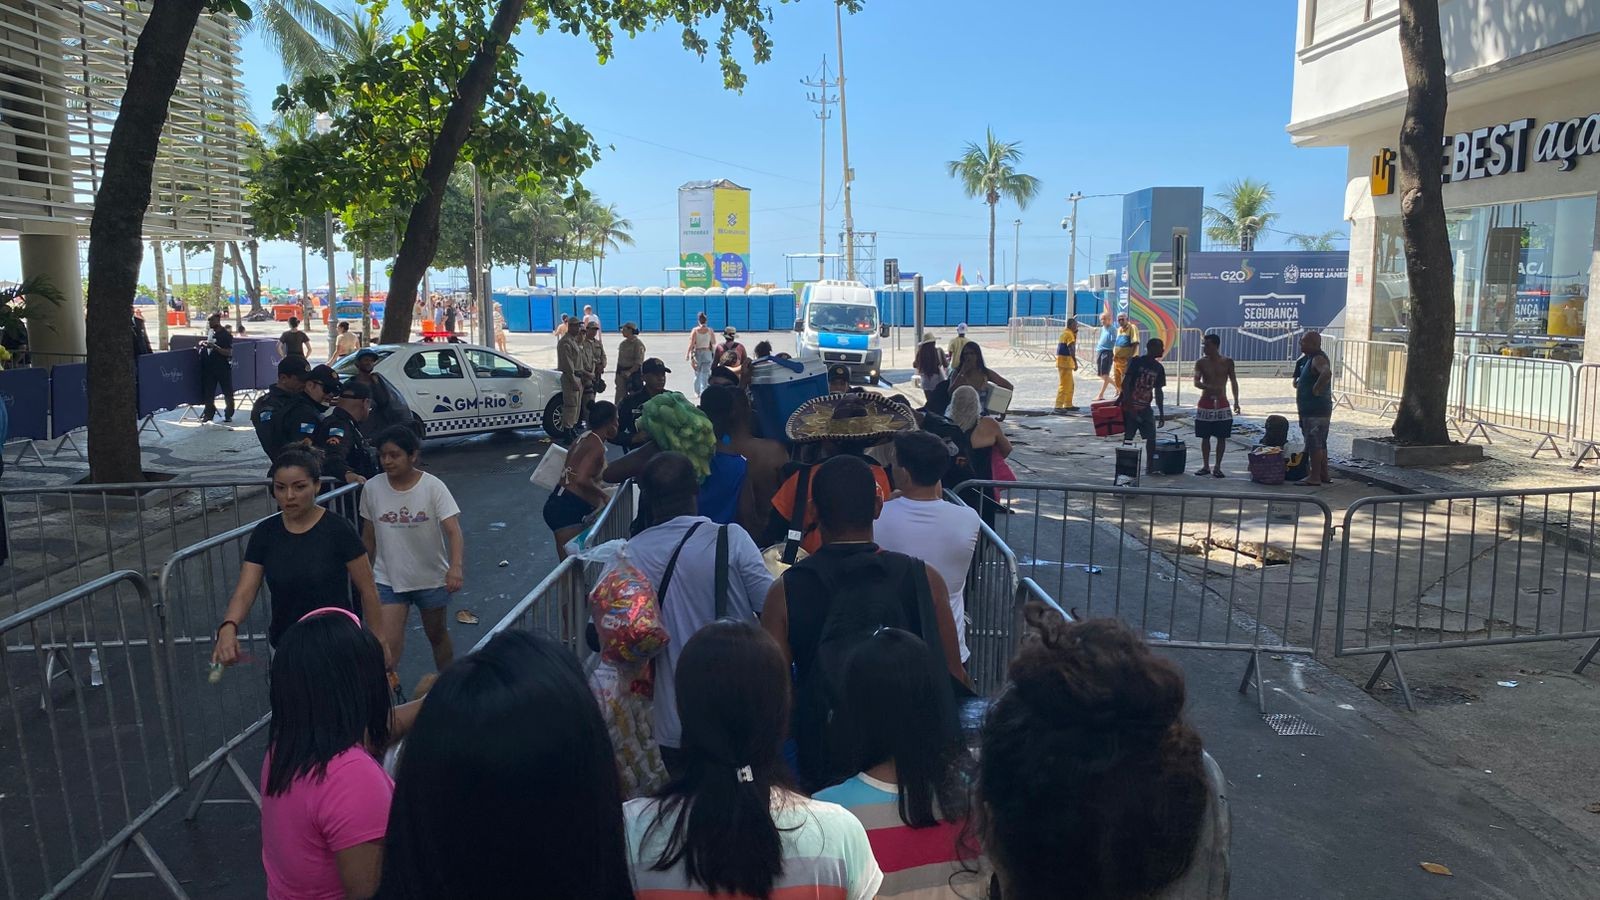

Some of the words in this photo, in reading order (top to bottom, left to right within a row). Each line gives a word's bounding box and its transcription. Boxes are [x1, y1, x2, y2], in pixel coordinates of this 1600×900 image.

[1220, 271, 1246, 281] G20
[1244, 307, 1299, 321] SEGURANÇA
[1243, 321, 1299, 329] PRESENTE
[454, 393, 507, 411] GM-Rio
